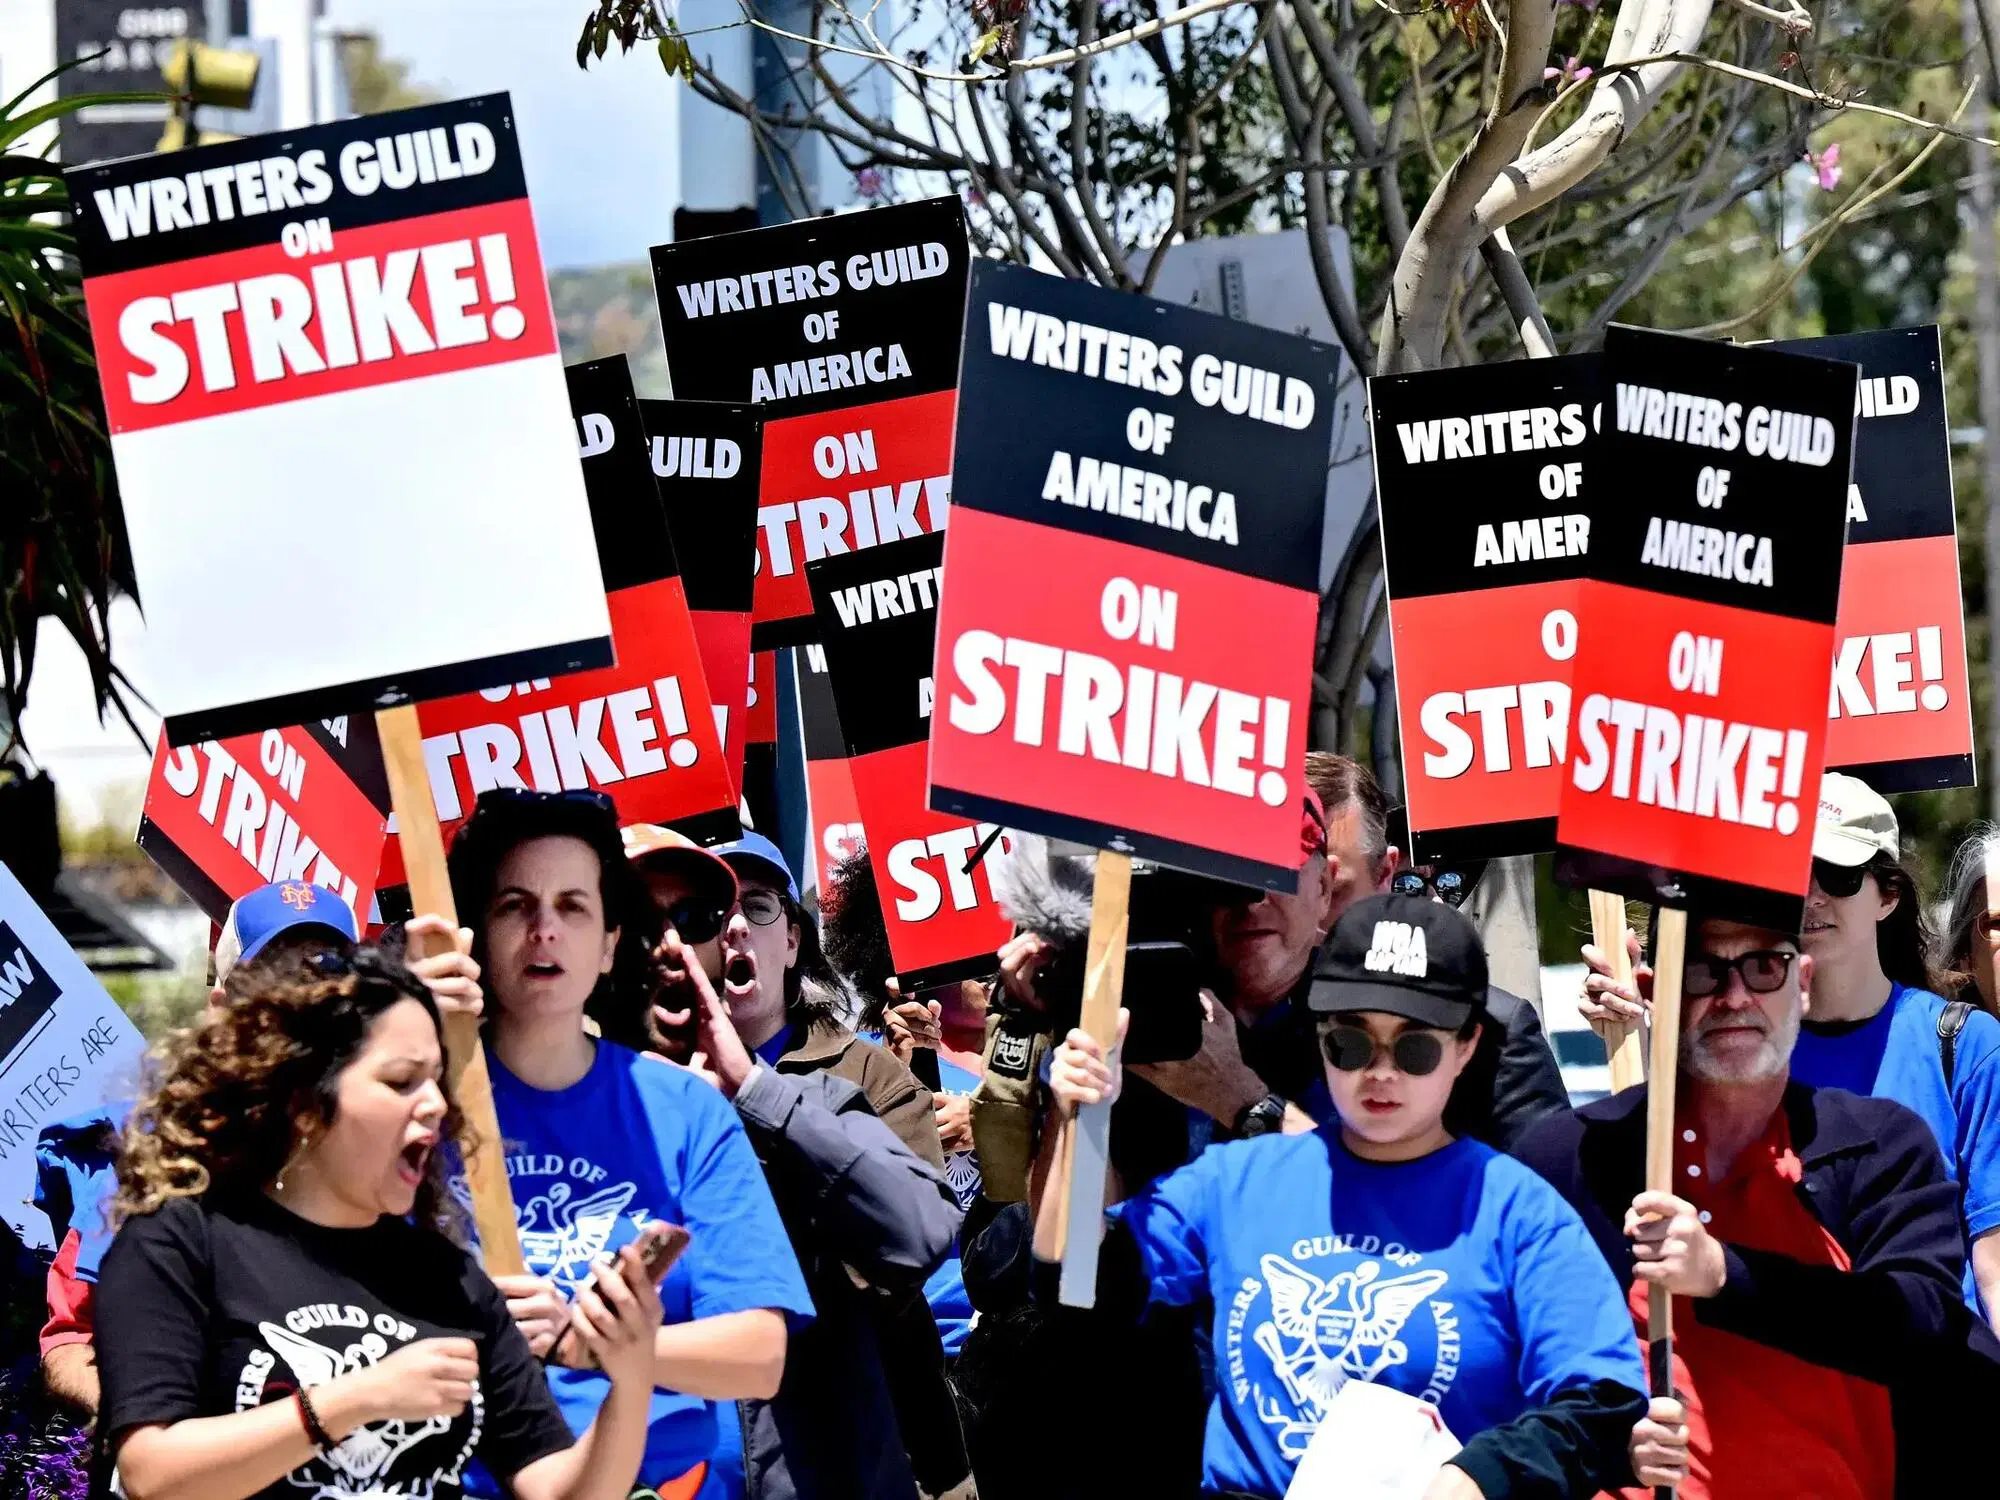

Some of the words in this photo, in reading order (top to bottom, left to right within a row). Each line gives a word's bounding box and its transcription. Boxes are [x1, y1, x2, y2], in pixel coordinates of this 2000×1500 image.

[94, 149, 332, 241] WRITERS
[339, 122, 496, 196] GUILD
[282, 217, 333, 258] ON
[677, 261, 840, 319] WRITERS
[846, 242, 949, 291] GUILD
[118, 233, 526, 405] STRIKE!
[803, 310, 839, 343] OF
[752, 344, 912, 402] AMERICA
[988, 302, 1184, 397] WRITERS
[1190, 354, 1315, 430] GUILD
[813, 429, 878, 480] ON
[1126, 406, 1175, 456] OF
[1397, 403, 1587, 464] WRITERS
[1616, 382, 1742, 451] WRITERS
[1745, 405, 1836, 466] GUILD
[645, 436, 741, 479] UILD
[1539, 462, 1583, 500] OF
[1696, 466, 1731, 509] OF
[1041, 450, 1239, 546] AMERICA
[1641, 517, 1773, 587] AMERICA
[1100, 576, 1178, 651] ON
[1668, 630, 1724, 697] ON
[949, 629, 1291, 807] STRIKE!
[261, 728, 306, 802] ON
[387, 676, 698, 833] TRIKE!
[1573, 693, 1808, 837] STRIKE!
[81, 1016, 119, 1065] ARE
[569, 1157, 609, 1184] OF
[1292, 1233, 1380, 1260] GUILD
[285, 1303, 369, 1334] GUILD
